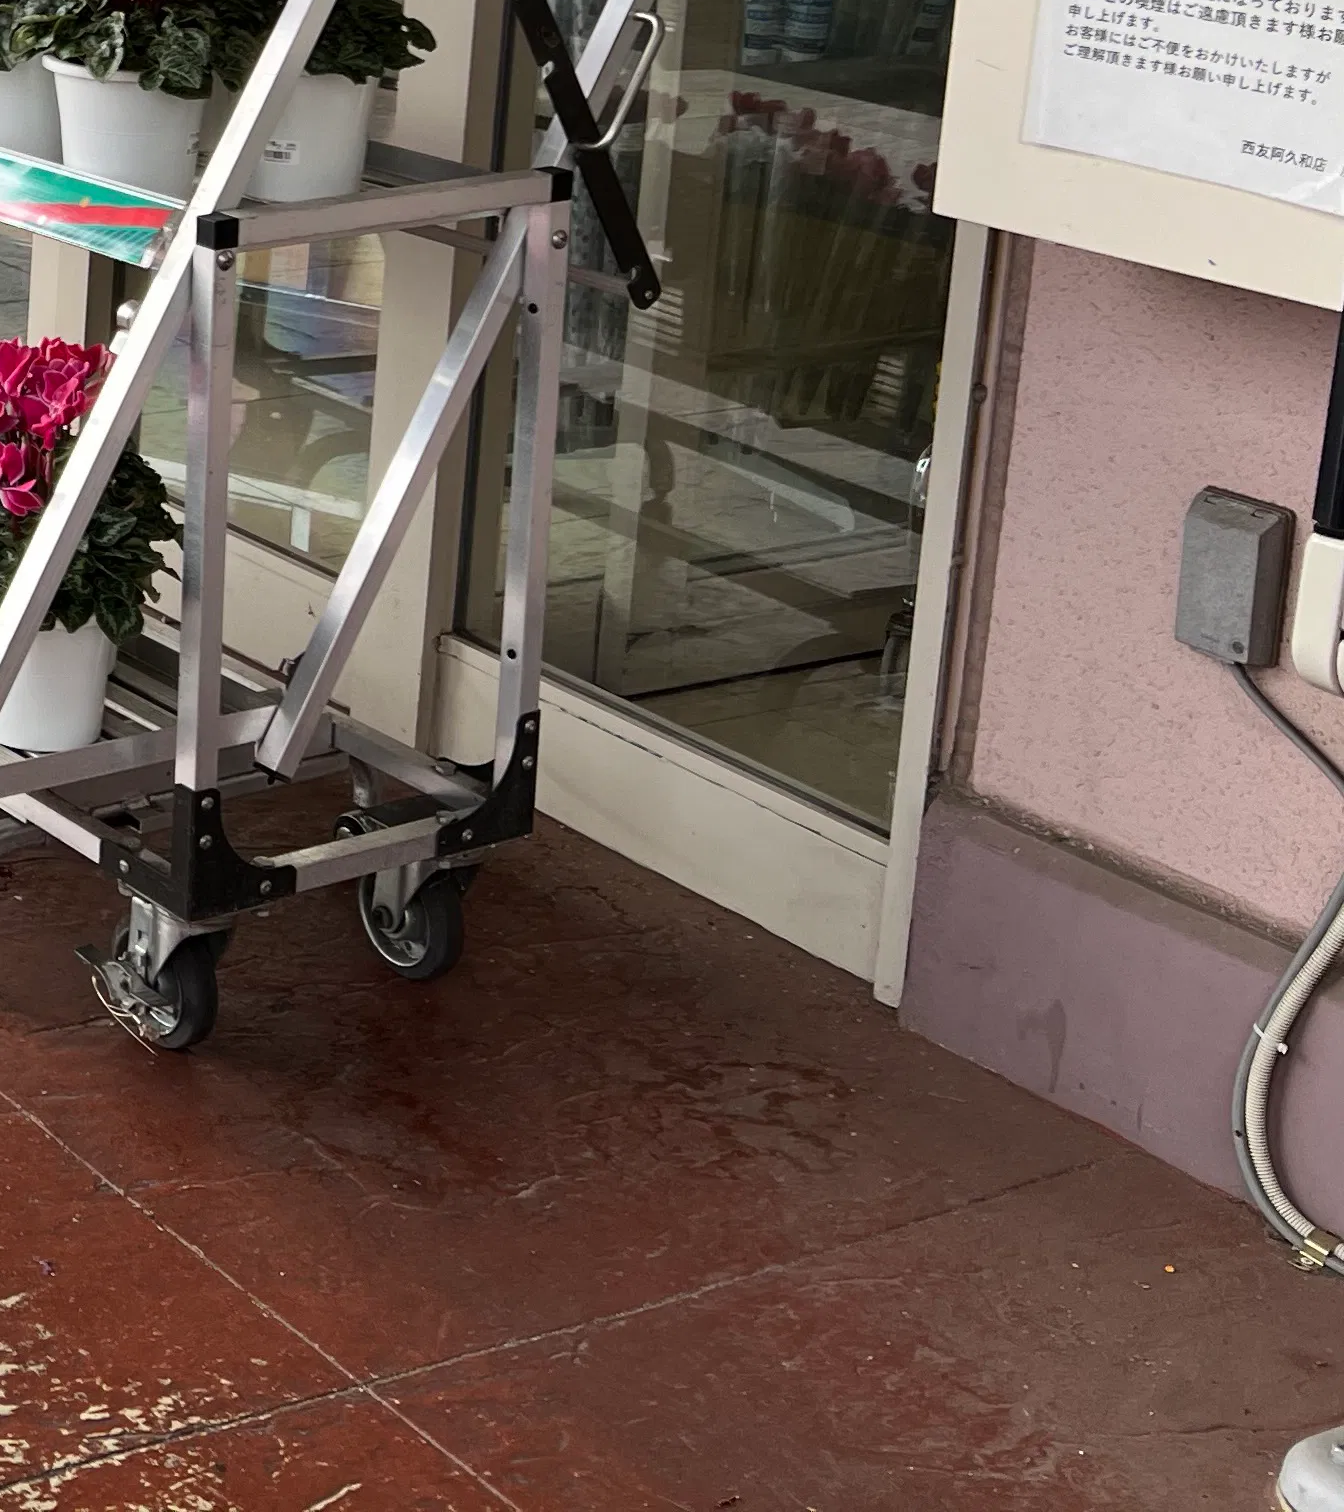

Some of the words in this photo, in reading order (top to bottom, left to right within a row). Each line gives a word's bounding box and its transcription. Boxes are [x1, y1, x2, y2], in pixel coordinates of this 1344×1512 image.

[1067, 3, 1160, 33] 申し上げます。
[1063, 44, 1319, 106] ご理解頂きます様お願い申し上げます。
[1065, 25, 1331, 85] お客様にはご不便をおかけいたしますが
[1240, 139, 1329, 172] 西友阿久和店
